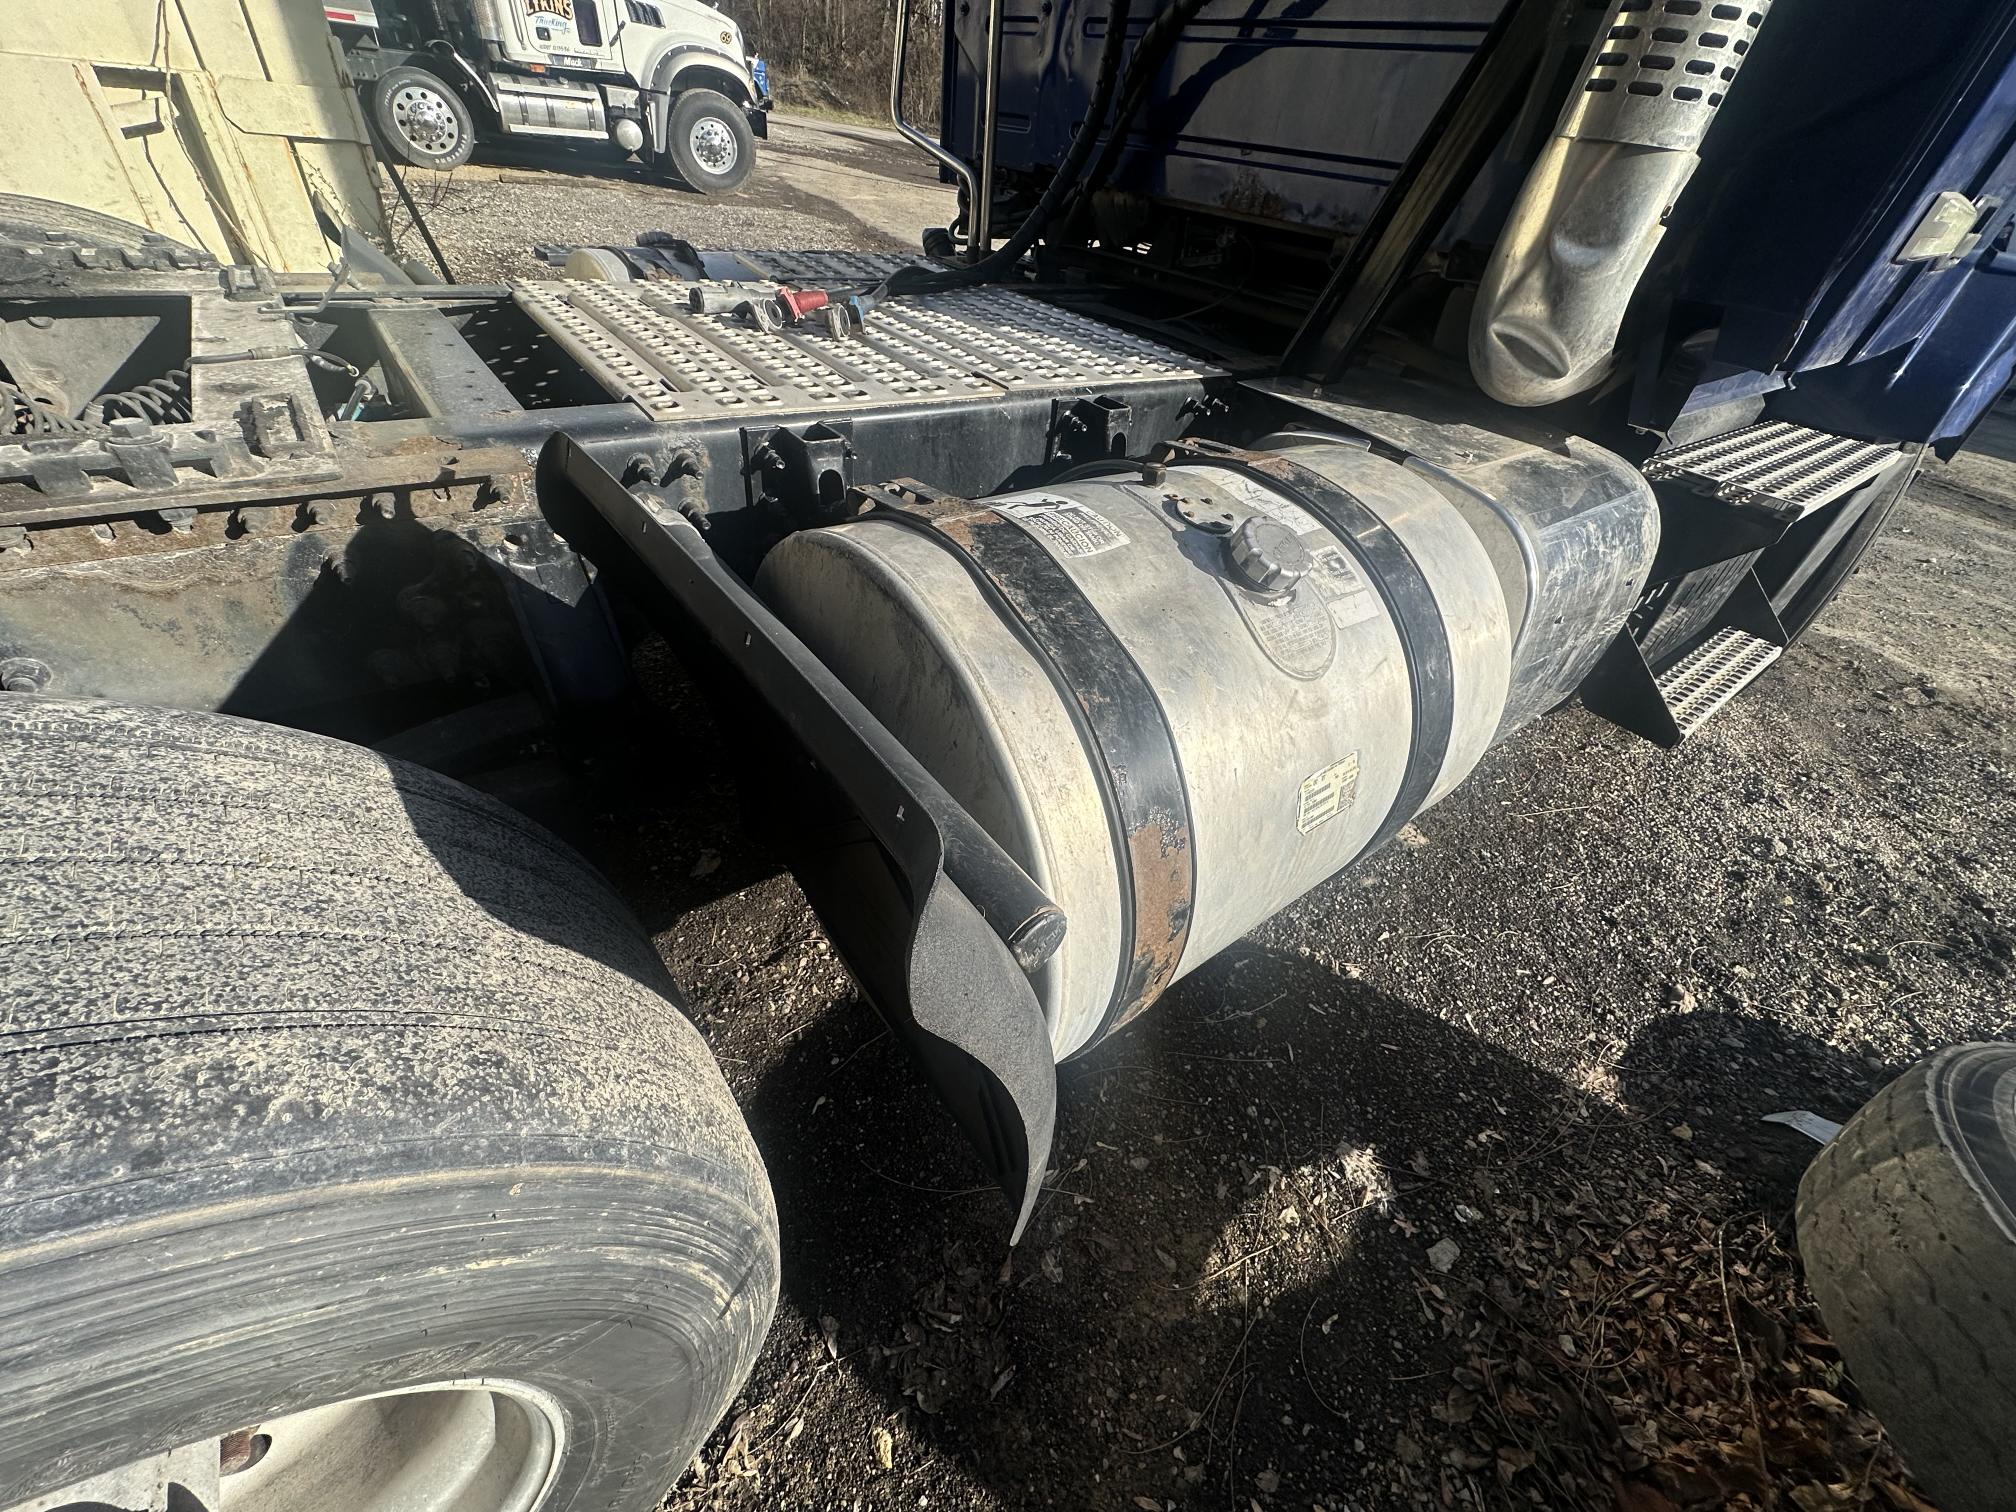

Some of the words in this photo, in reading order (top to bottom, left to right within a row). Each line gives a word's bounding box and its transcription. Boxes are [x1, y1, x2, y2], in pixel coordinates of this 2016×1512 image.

[720, 31, 732, 44] 69
[563, 56, 583, 67] Mack
[1086, 509, 1122, 538] CAUTION
